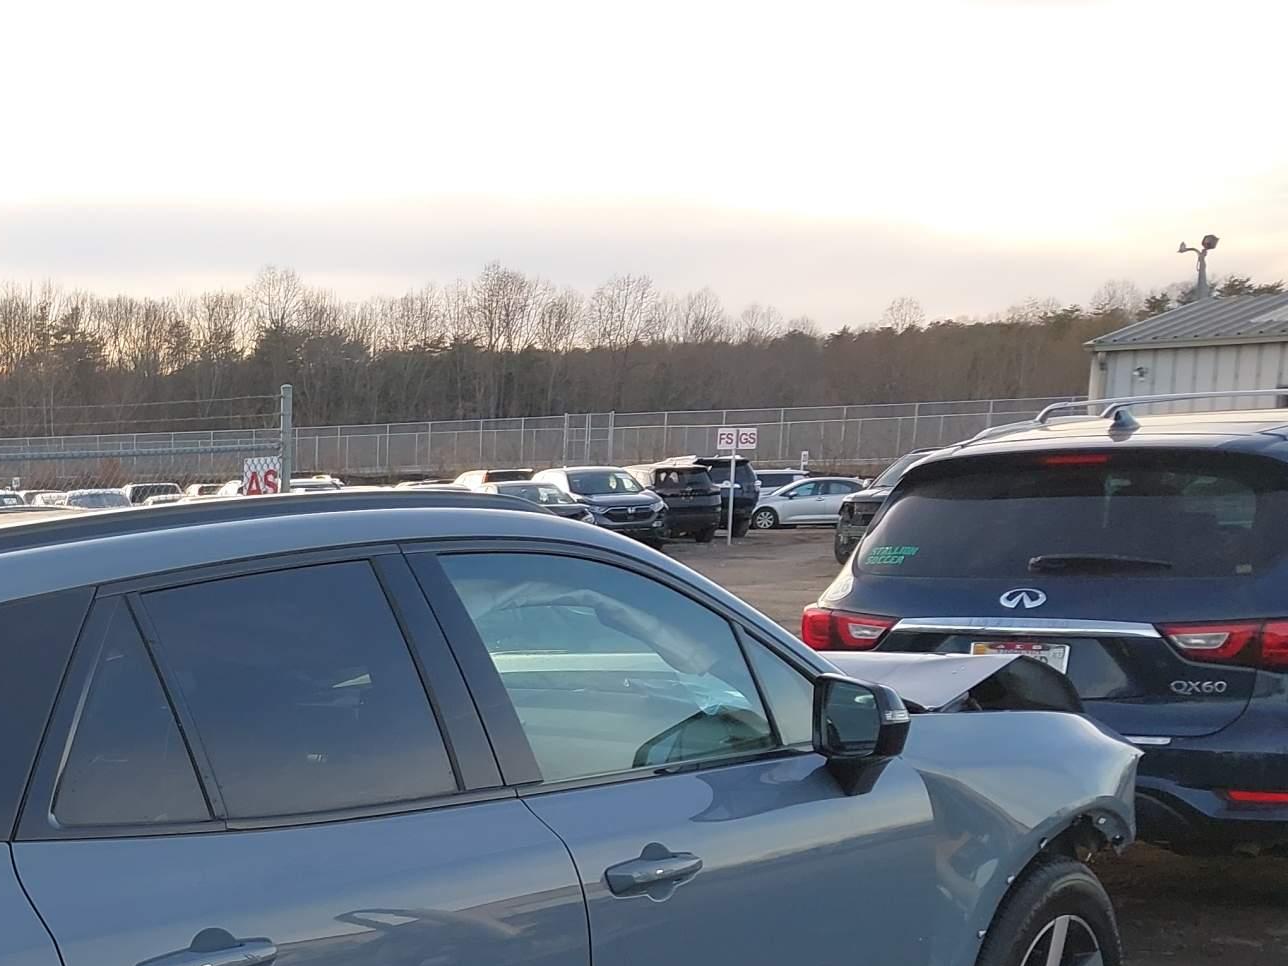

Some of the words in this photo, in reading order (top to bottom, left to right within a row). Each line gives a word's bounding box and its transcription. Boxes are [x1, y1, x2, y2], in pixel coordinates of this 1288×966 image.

[719, 432, 733, 445] FS
[740, 432, 756, 445] GS
[247, 469, 278, 495] AS
[865, 555, 905, 566] SOCCER
[1170, 680, 1227, 695] QX60
